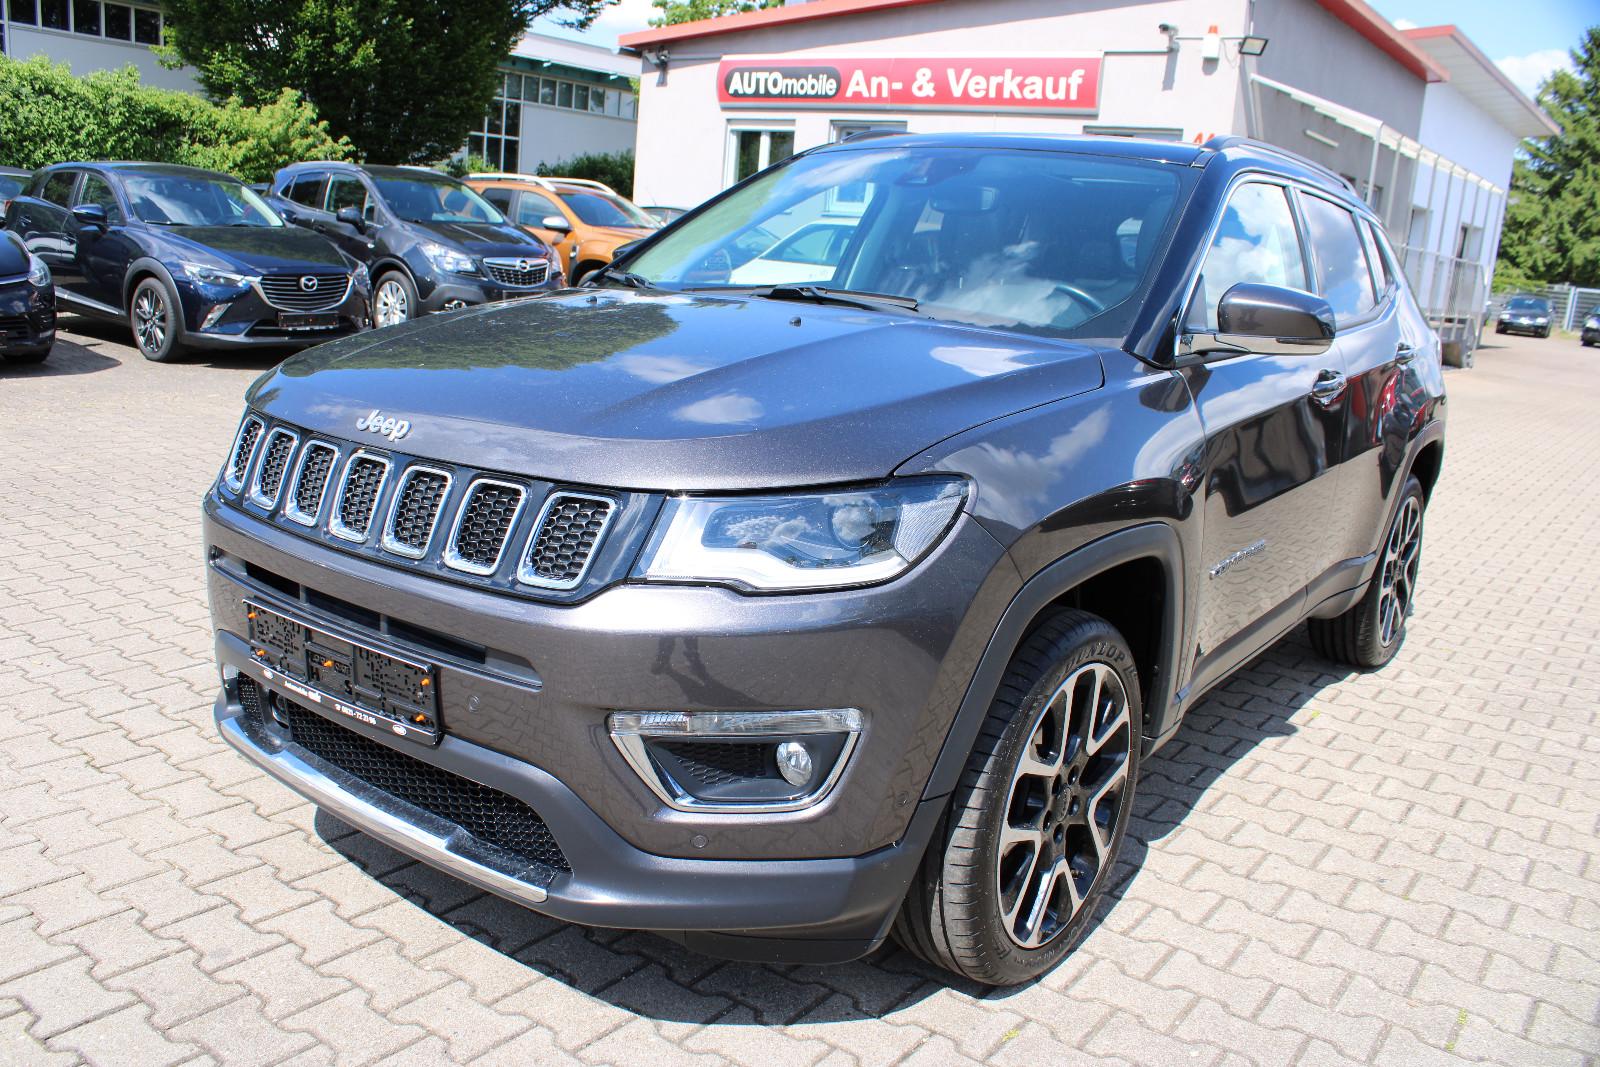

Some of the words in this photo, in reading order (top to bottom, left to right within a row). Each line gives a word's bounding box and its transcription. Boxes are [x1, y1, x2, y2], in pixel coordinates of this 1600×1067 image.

[728, 71, 837, 96] AUTOmobile
[845, 69, 903, 98] An-
[911, 67, 936, 98] &
[946, 68, 1086, 101] Verkauf
[356, 409, 412, 442] Jeep
